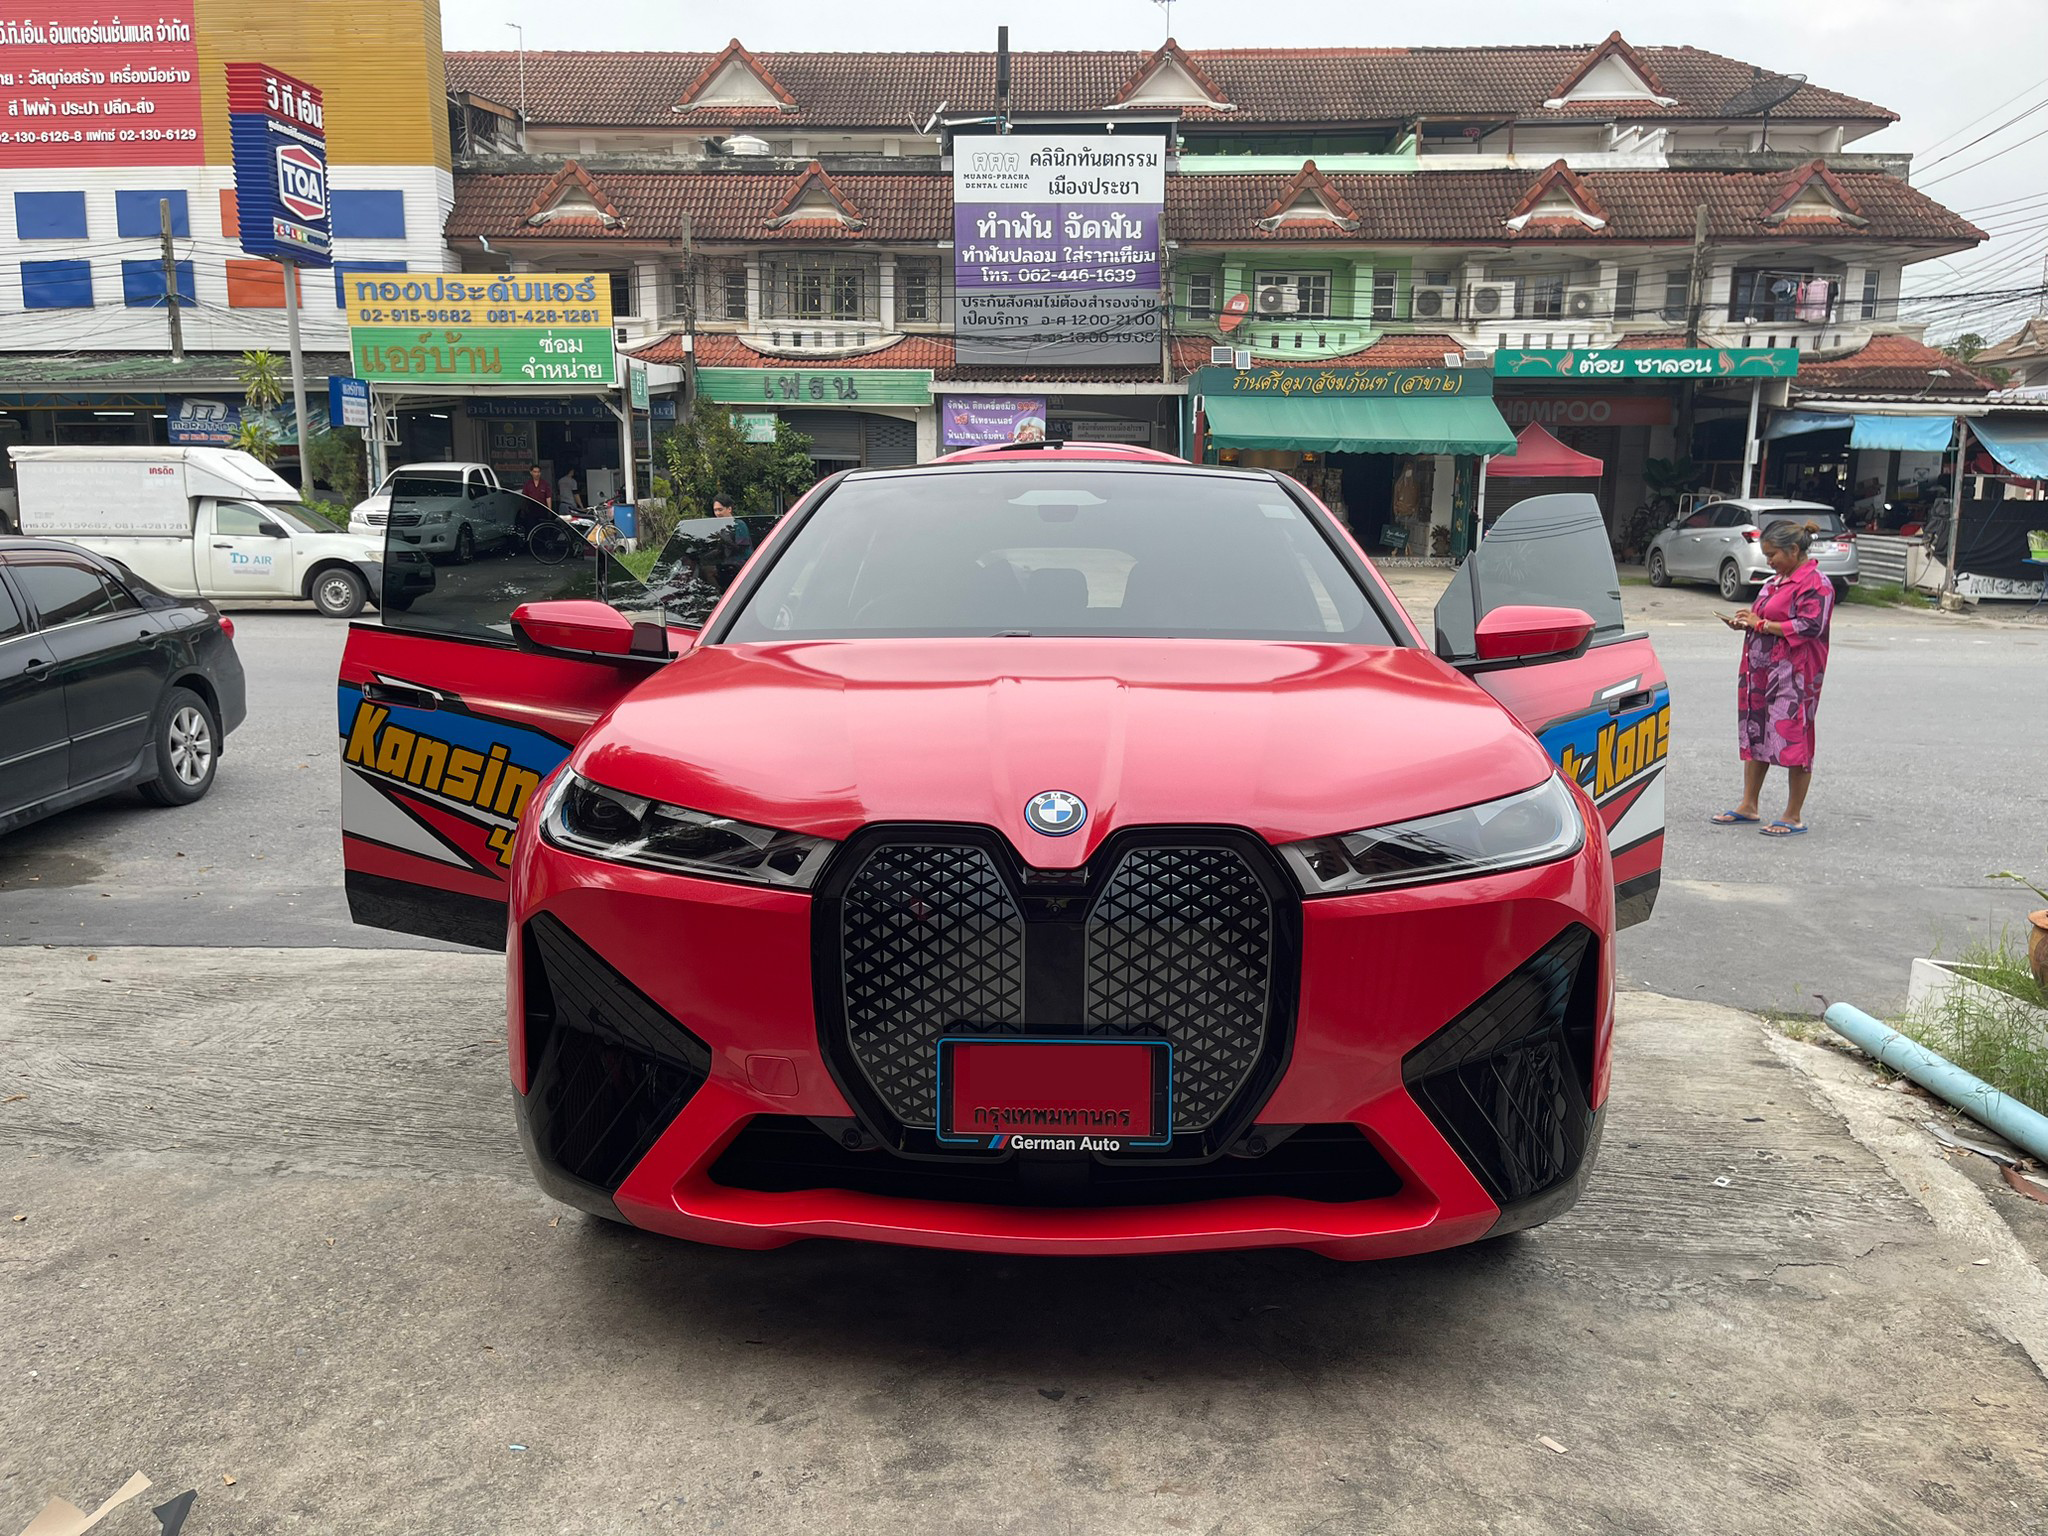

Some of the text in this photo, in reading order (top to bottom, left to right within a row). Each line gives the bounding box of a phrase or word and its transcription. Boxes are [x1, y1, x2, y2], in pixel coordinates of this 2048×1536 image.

[49, 16, 153, 43] อินเตอร์เนชั่นแนล
[157, 17, 190, 42] จำกัด
[29, 68, 105, 89] วัสดุก่อสร้าง
[110, 64, 190, 84] เครื่องมือช่าง
[8, 99, 18, 116] สี
[22, 97, 57, 116] ไฟฟ้า
[61, 101, 99, 115] ประปา
[296, 89, 323, 129] เอ็น
[119, 129, 197, 141] 02-130-6129
[1030, 147, 1158, 167] คลินิกทันตกรรม
[283, 162, 321, 201] TOA
[1049, 174, 1140, 196] เมืองประชา
[976, 211, 1142, 239] ทำฟัน จัดฟัน
[962, 245, 1156, 263] ทำฟันปลอม ใส่รากเทียม
[980, 266, 1136, 283] โทร. 062-446-1639
[356, 275, 596, 302] ทองประดับแอร์
[961, 295, 1156, 309] ประกันสังคมไม่ต้องสำรองจ่าย
[360, 309, 599, 323] 02-915-9682 081-428-1281
[962, 310, 1029, 326] เปิดบริการ
[1071, 314, 1155, 326] 12.00-21.00
[361, 329, 583, 374] แอร์บ้าน ซ่อม
[522, 356, 603, 379] จำหน่าย
[1579, 352, 1712, 374] ต้อย ซาลอน
[1500, 400, 1611, 422] HAMPOO
[230, 552, 272, 565] TD AIR
[1034, 792, 1078, 806] BMW
[973, 1106, 1130, 1129] กรุงเทพมหานคร
[1010, 1135, 1120, 1151] German Auto
